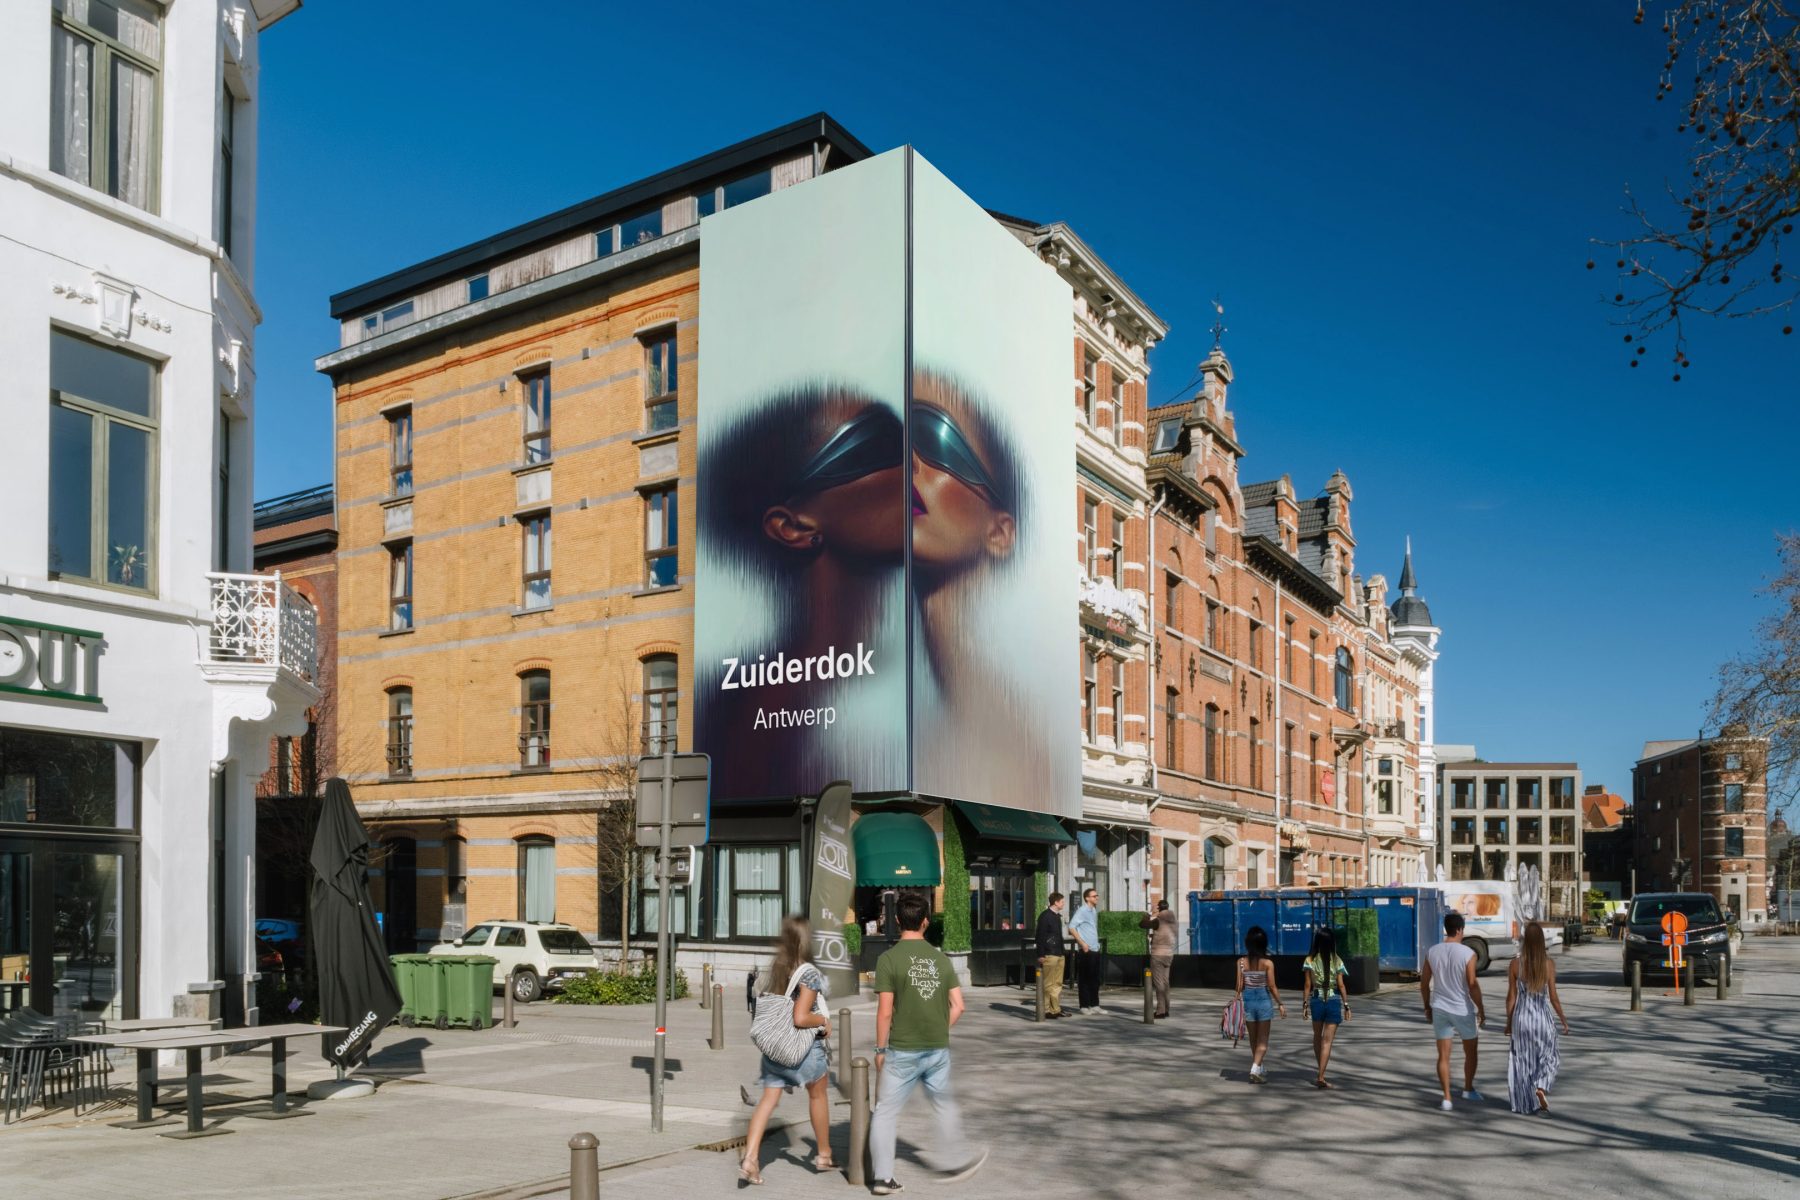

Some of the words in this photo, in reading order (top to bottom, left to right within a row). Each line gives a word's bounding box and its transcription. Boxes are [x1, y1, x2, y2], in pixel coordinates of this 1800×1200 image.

[721, 642, 875, 690] Zuiderdok
[753, 706, 836, 730] Antwerp
[335, 1011, 377, 1056] OMMEGANG
